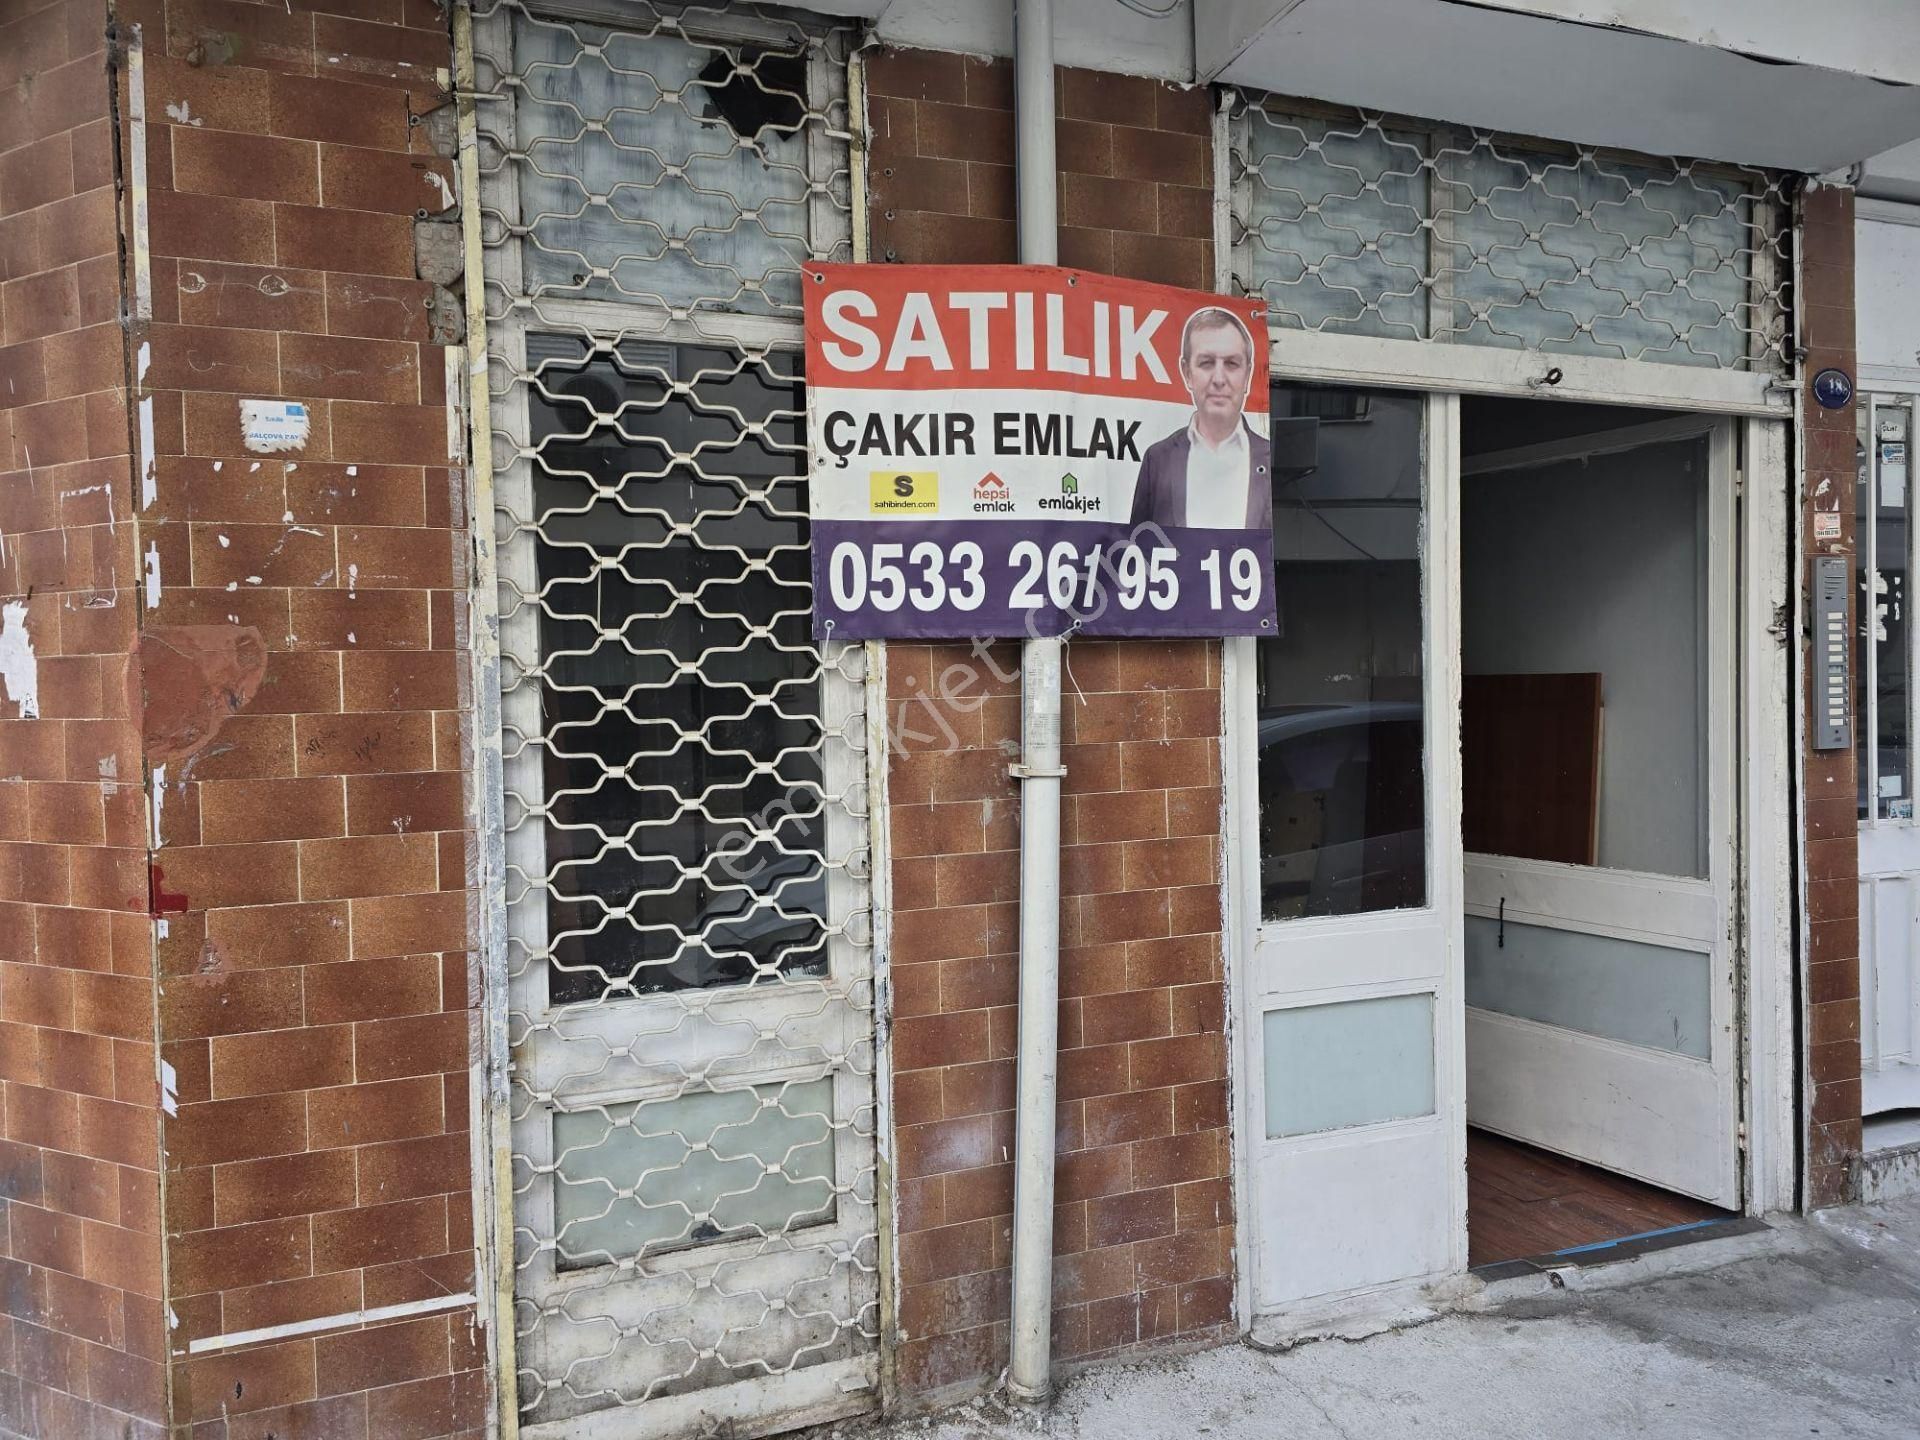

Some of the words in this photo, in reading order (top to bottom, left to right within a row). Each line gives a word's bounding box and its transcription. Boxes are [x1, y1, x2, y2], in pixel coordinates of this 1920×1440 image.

[820, 289, 1172, 385] SATILIK
[823, 410, 976, 468] ÇAKIR
[993, 412, 1142, 463] EMLAK
[874, 500, 936, 509] sahibinden.com
[973, 488, 1010, 502] hepsi
[1038, 495, 1101, 514] emlakjet
[973, 501, 1015, 513] emlak
[829, 540, 986, 612] 0533
[1008, 540, 1102, 610] 261
[1117, 544, 1180, 612] 95
[1200, 548, 1262, 612] 19
